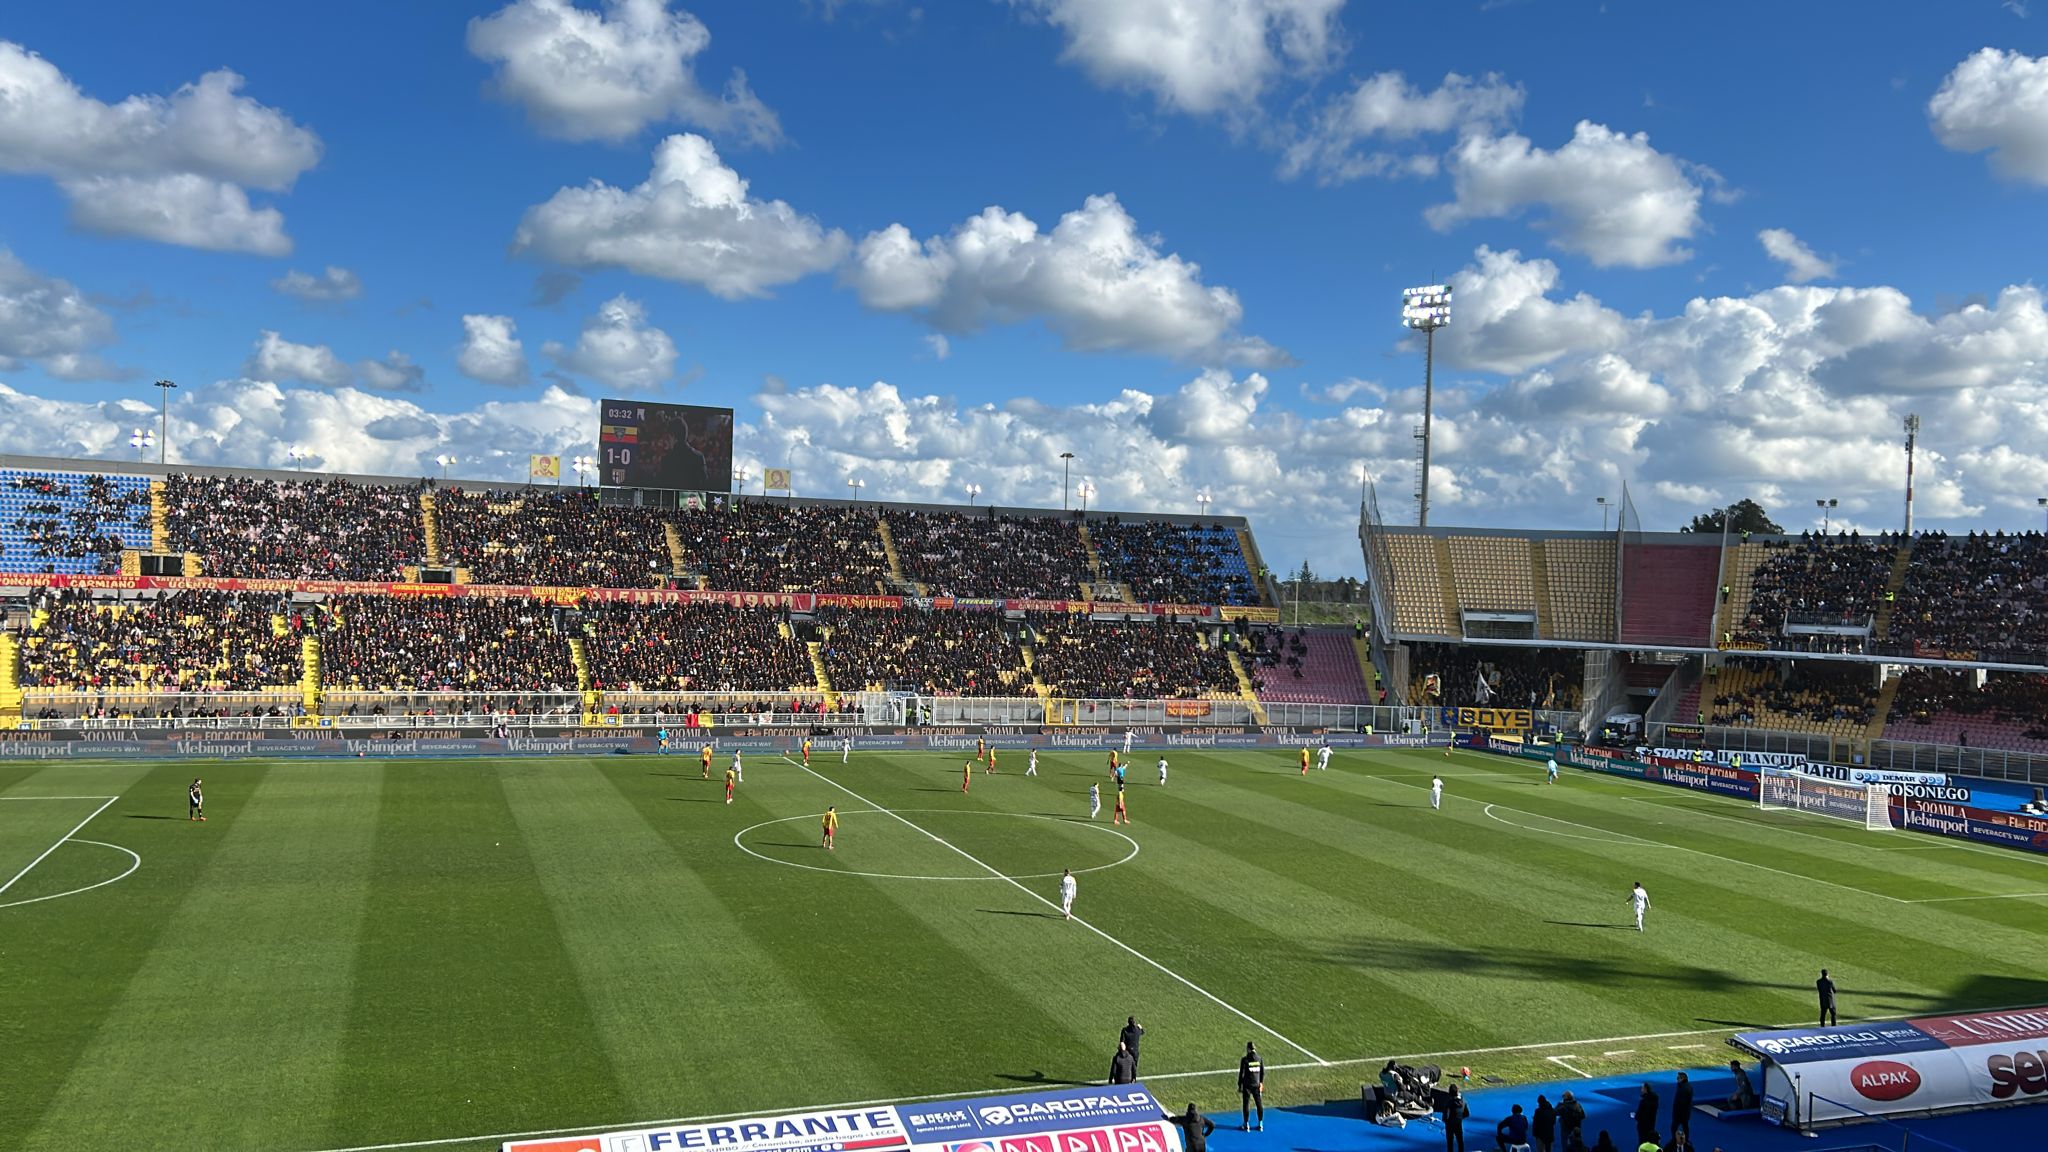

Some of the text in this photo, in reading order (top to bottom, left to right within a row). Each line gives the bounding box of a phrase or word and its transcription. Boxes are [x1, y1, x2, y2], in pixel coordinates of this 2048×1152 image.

[608, 408, 632, 419] 03:32
[607, 447, 631, 465] 1-0
[70, 579, 136, 588] CARMIANO
[589, 591, 679, 605] ALENTO
[1461, 708, 1530, 727] BOYS
[79, 731, 139, 741] 300MILA
[205, 731, 265, 740] FOCACCIAMI
[290, 730, 345, 740] 300MILA
[406, 730, 461, 740] FOCACCIAMI
[591, 729, 643, 738] FOCACCIAMI
[764, 728, 810, 737] FOCACCIAMI
[921, 727, 965, 736] FOCACCIAMI
[983, 726, 1023, 735] 300MILA
[1068, 727, 1109, 735] FOCACCIAMI
[1205, 727, 1245, 735] FOCACCIAMI
[507, 739, 574, 753] Mebimport
[668, 738, 720, 751] ebimport
[1051, 734, 1102, 748] Mebimport
[1166, 734, 1216, 748] Mebimport
[1277, 734, 1324, 747] Mebimport
[1384, 734, 1429, 746] Mebimport
[0, 741, 72, 758] ebimport
[177, 741, 315, 756] Mebimport BEVERAGE'S WAY
[347, 740, 417, 754] Mebimport
[1653, 747, 1714, 761] STARTR
[1662, 767, 1708, 787] Mebimport
[1711, 781, 1738, 790] BEVERAGE'S
[1698, 765, 1738, 780] FOCACCIAMI
[1883, 774, 1916, 782] DEMAR
[1905, 785, 1969, 801] SONEGO
[1915, 800, 1967, 818] 300MILA
[1905, 810, 2029, 842] Mebimport BEVERAGE'S WAY
[1861, 1071, 1911, 1088] ALPAK
[648, 1111, 895, 1151] FERRANTE
[870, 1129, 898, 1137] LECCE
